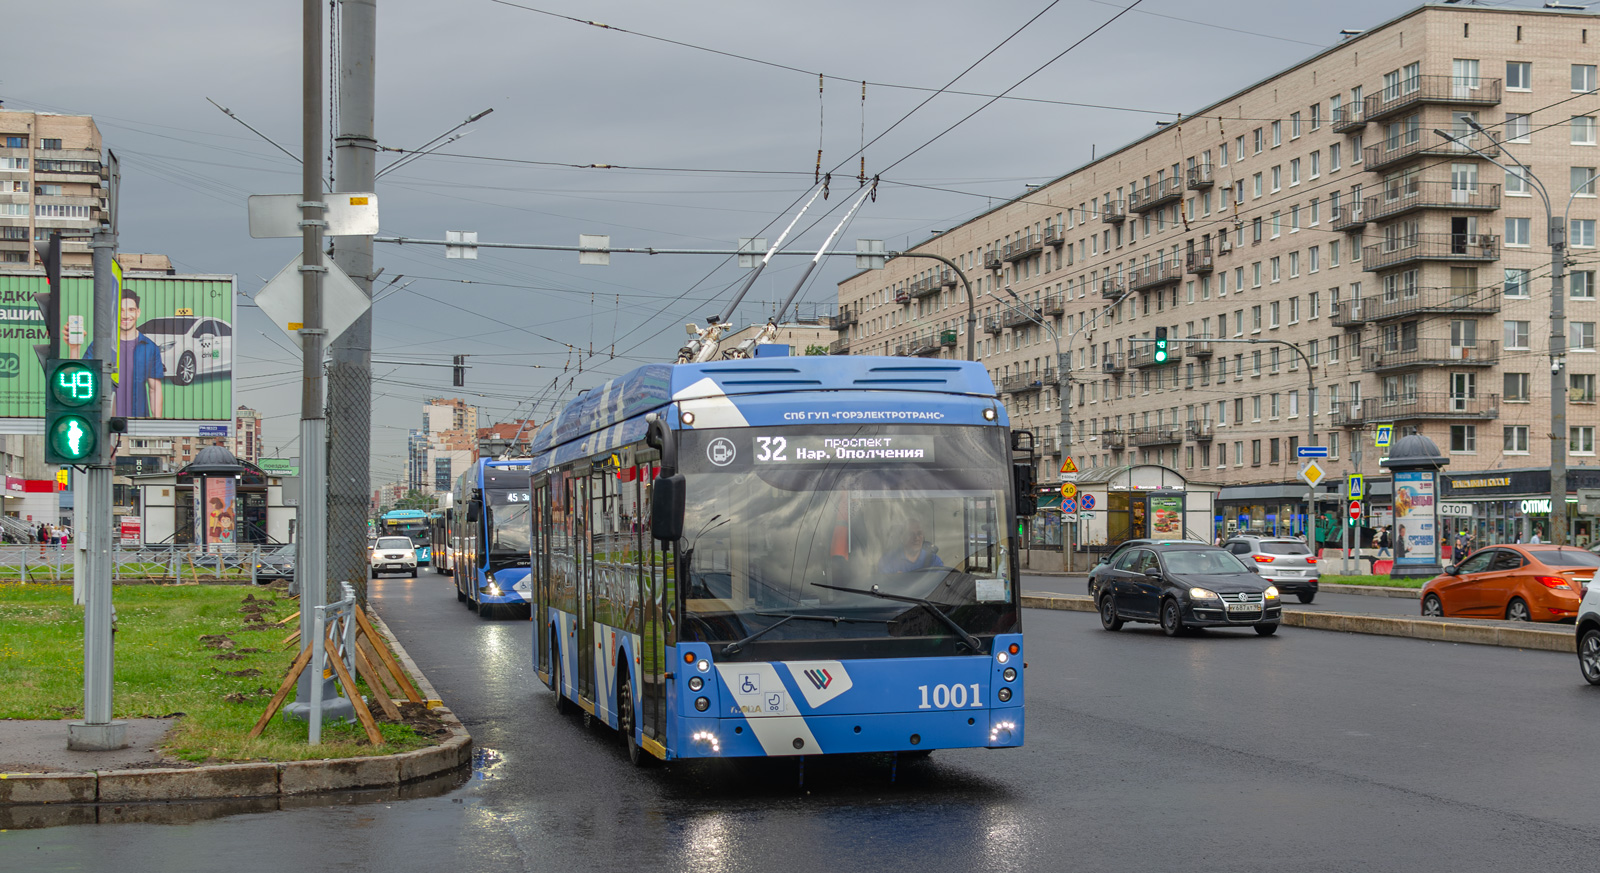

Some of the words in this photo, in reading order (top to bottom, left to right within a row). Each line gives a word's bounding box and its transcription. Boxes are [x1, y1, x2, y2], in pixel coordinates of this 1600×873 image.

[0, 290, 37, 303] дки
[0, 328, 50, 339] илам
[60, 371, 93, 399] 49
[808, 411, 830, 420] ГУП
[832, 411, 945, 420] «ГОРЭЛЕКТРОТРАНС»
[757, 436, 787, 461] 32
[824, 438, 892, 448] проспект
[796, 448, 831, 460] Нар.
[836, 448, 924, 459] Ополчения
[508, 493, 518, 502] 45
[1441, 504, 1468, 515] СТОП
[918, 683, 983, 709] 1001
